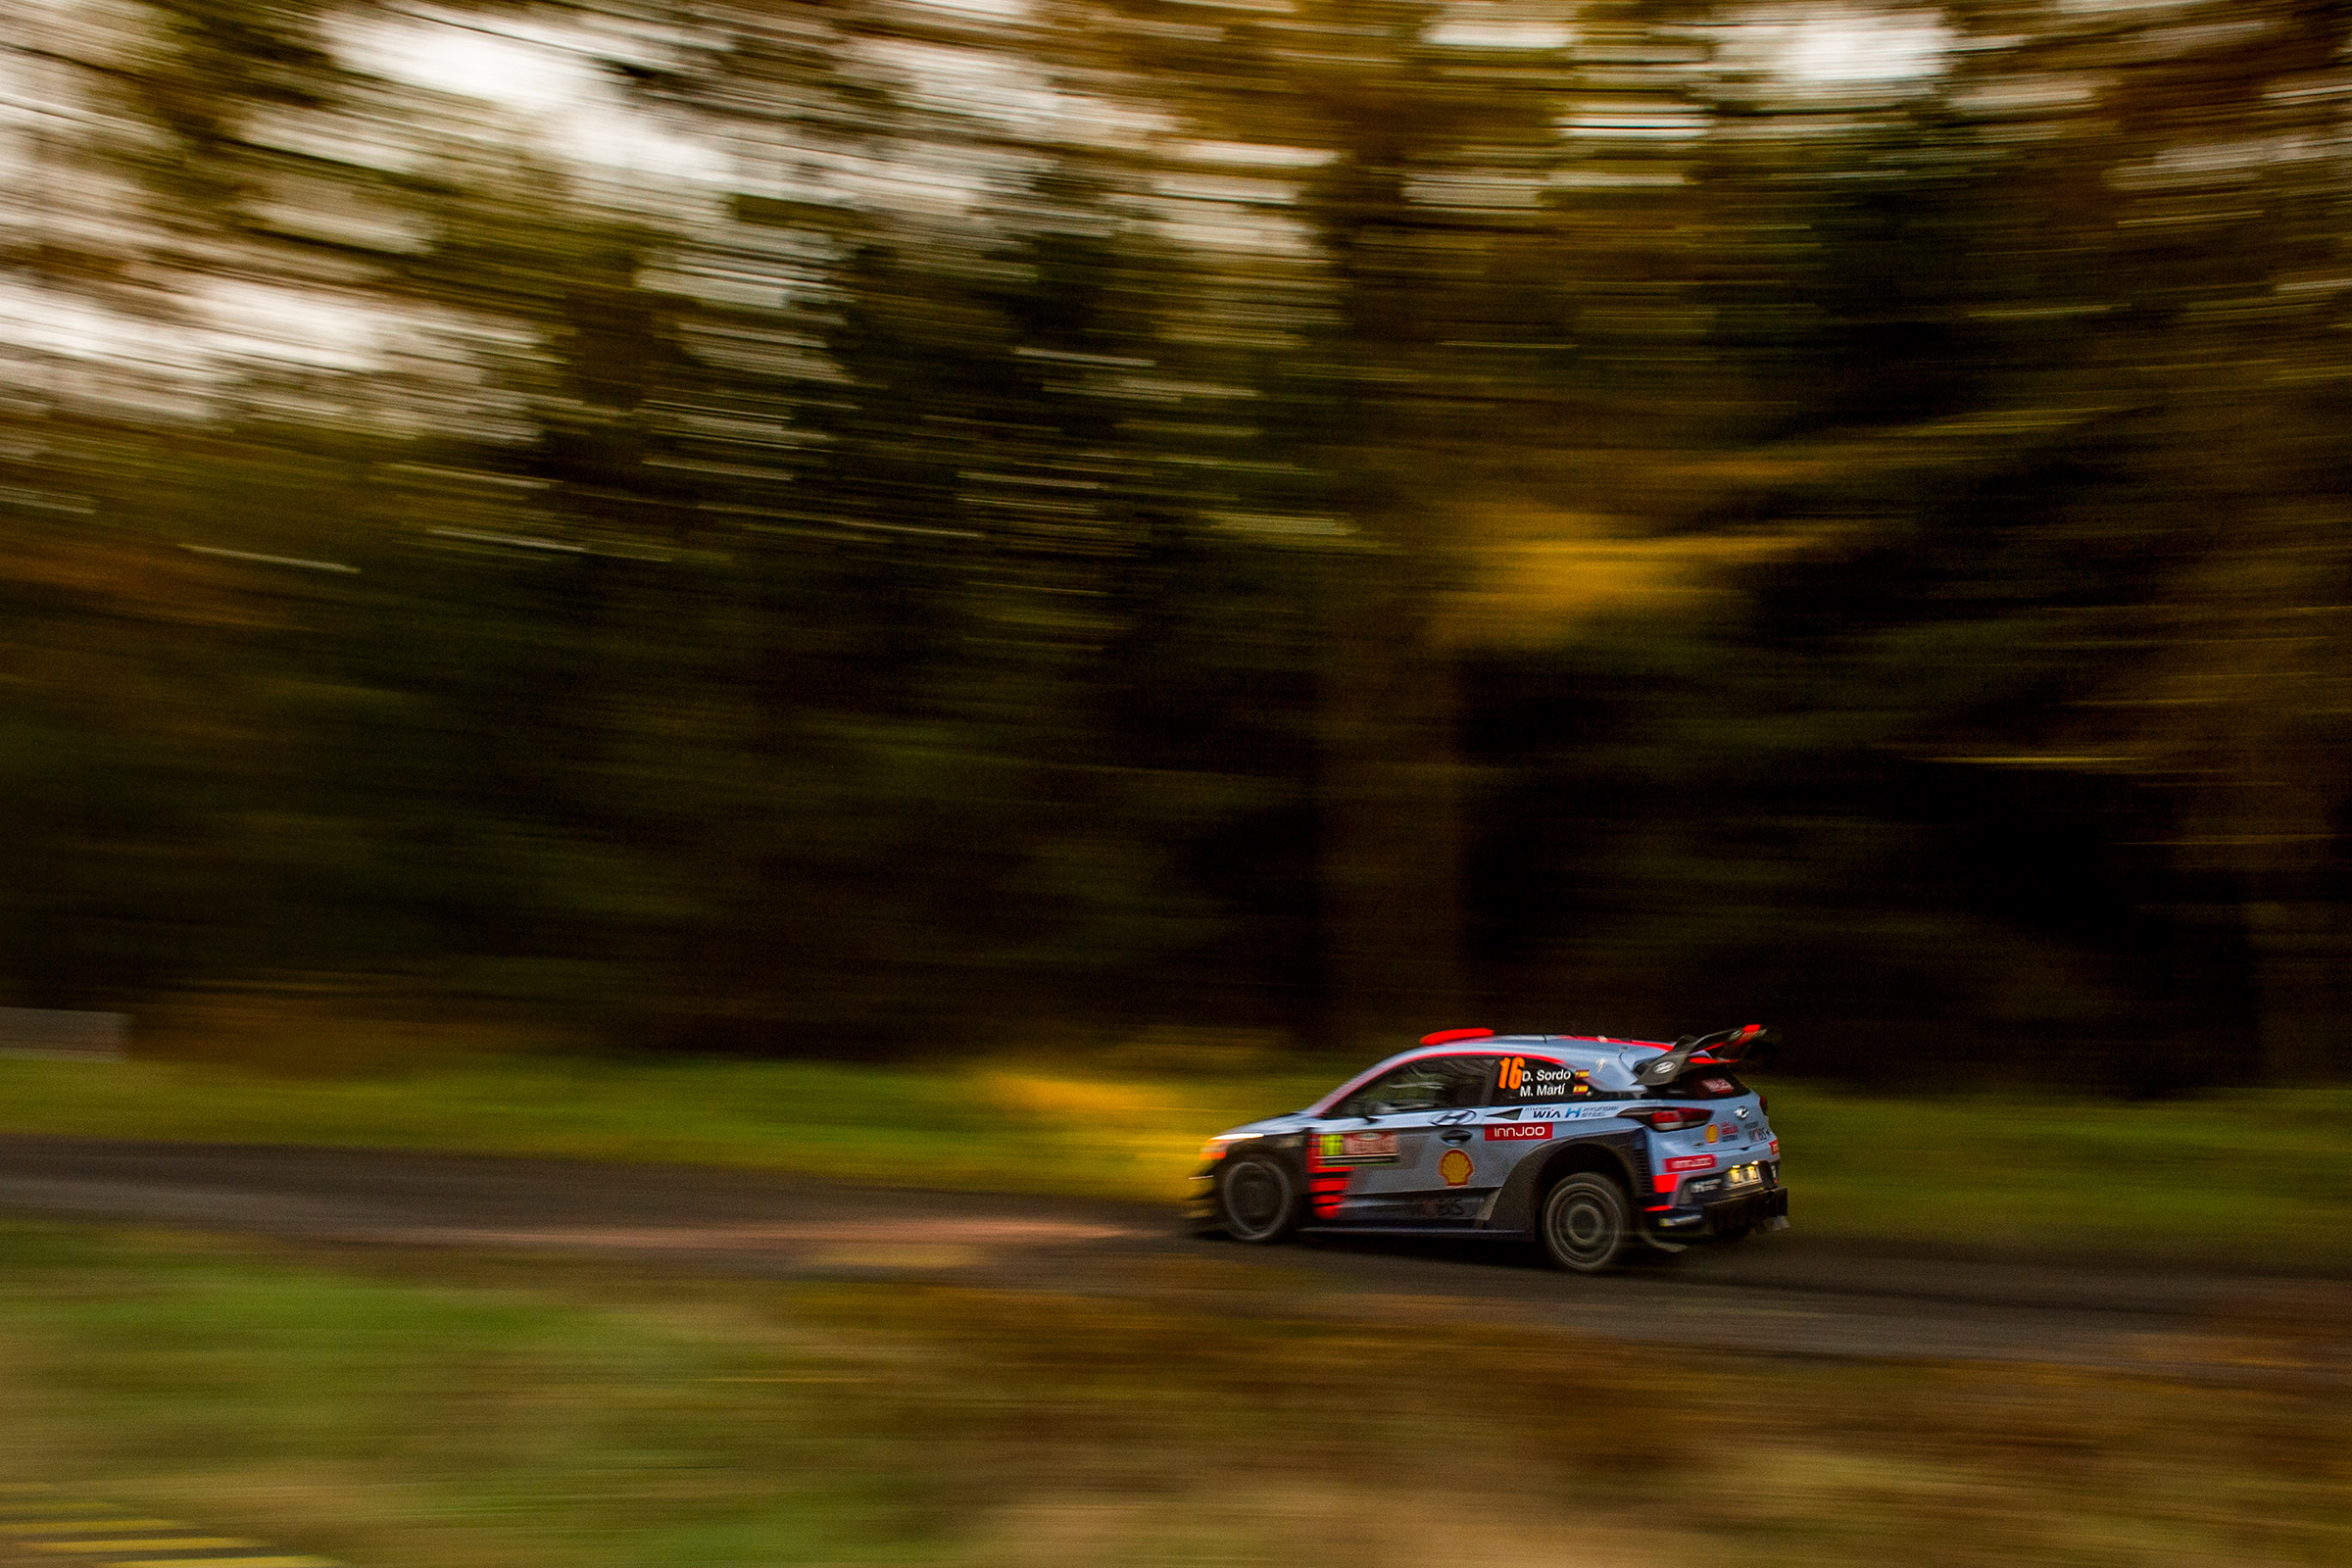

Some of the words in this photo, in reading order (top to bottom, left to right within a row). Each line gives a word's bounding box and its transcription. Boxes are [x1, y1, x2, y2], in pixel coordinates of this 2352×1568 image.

[1498, 1057, 1525, 1089] 16
[1522, 1070, 1534, 1082] D.
[1537, 1068, 1571, 1082] Sordo
[1520, 1085, 1534, 1097] M.
